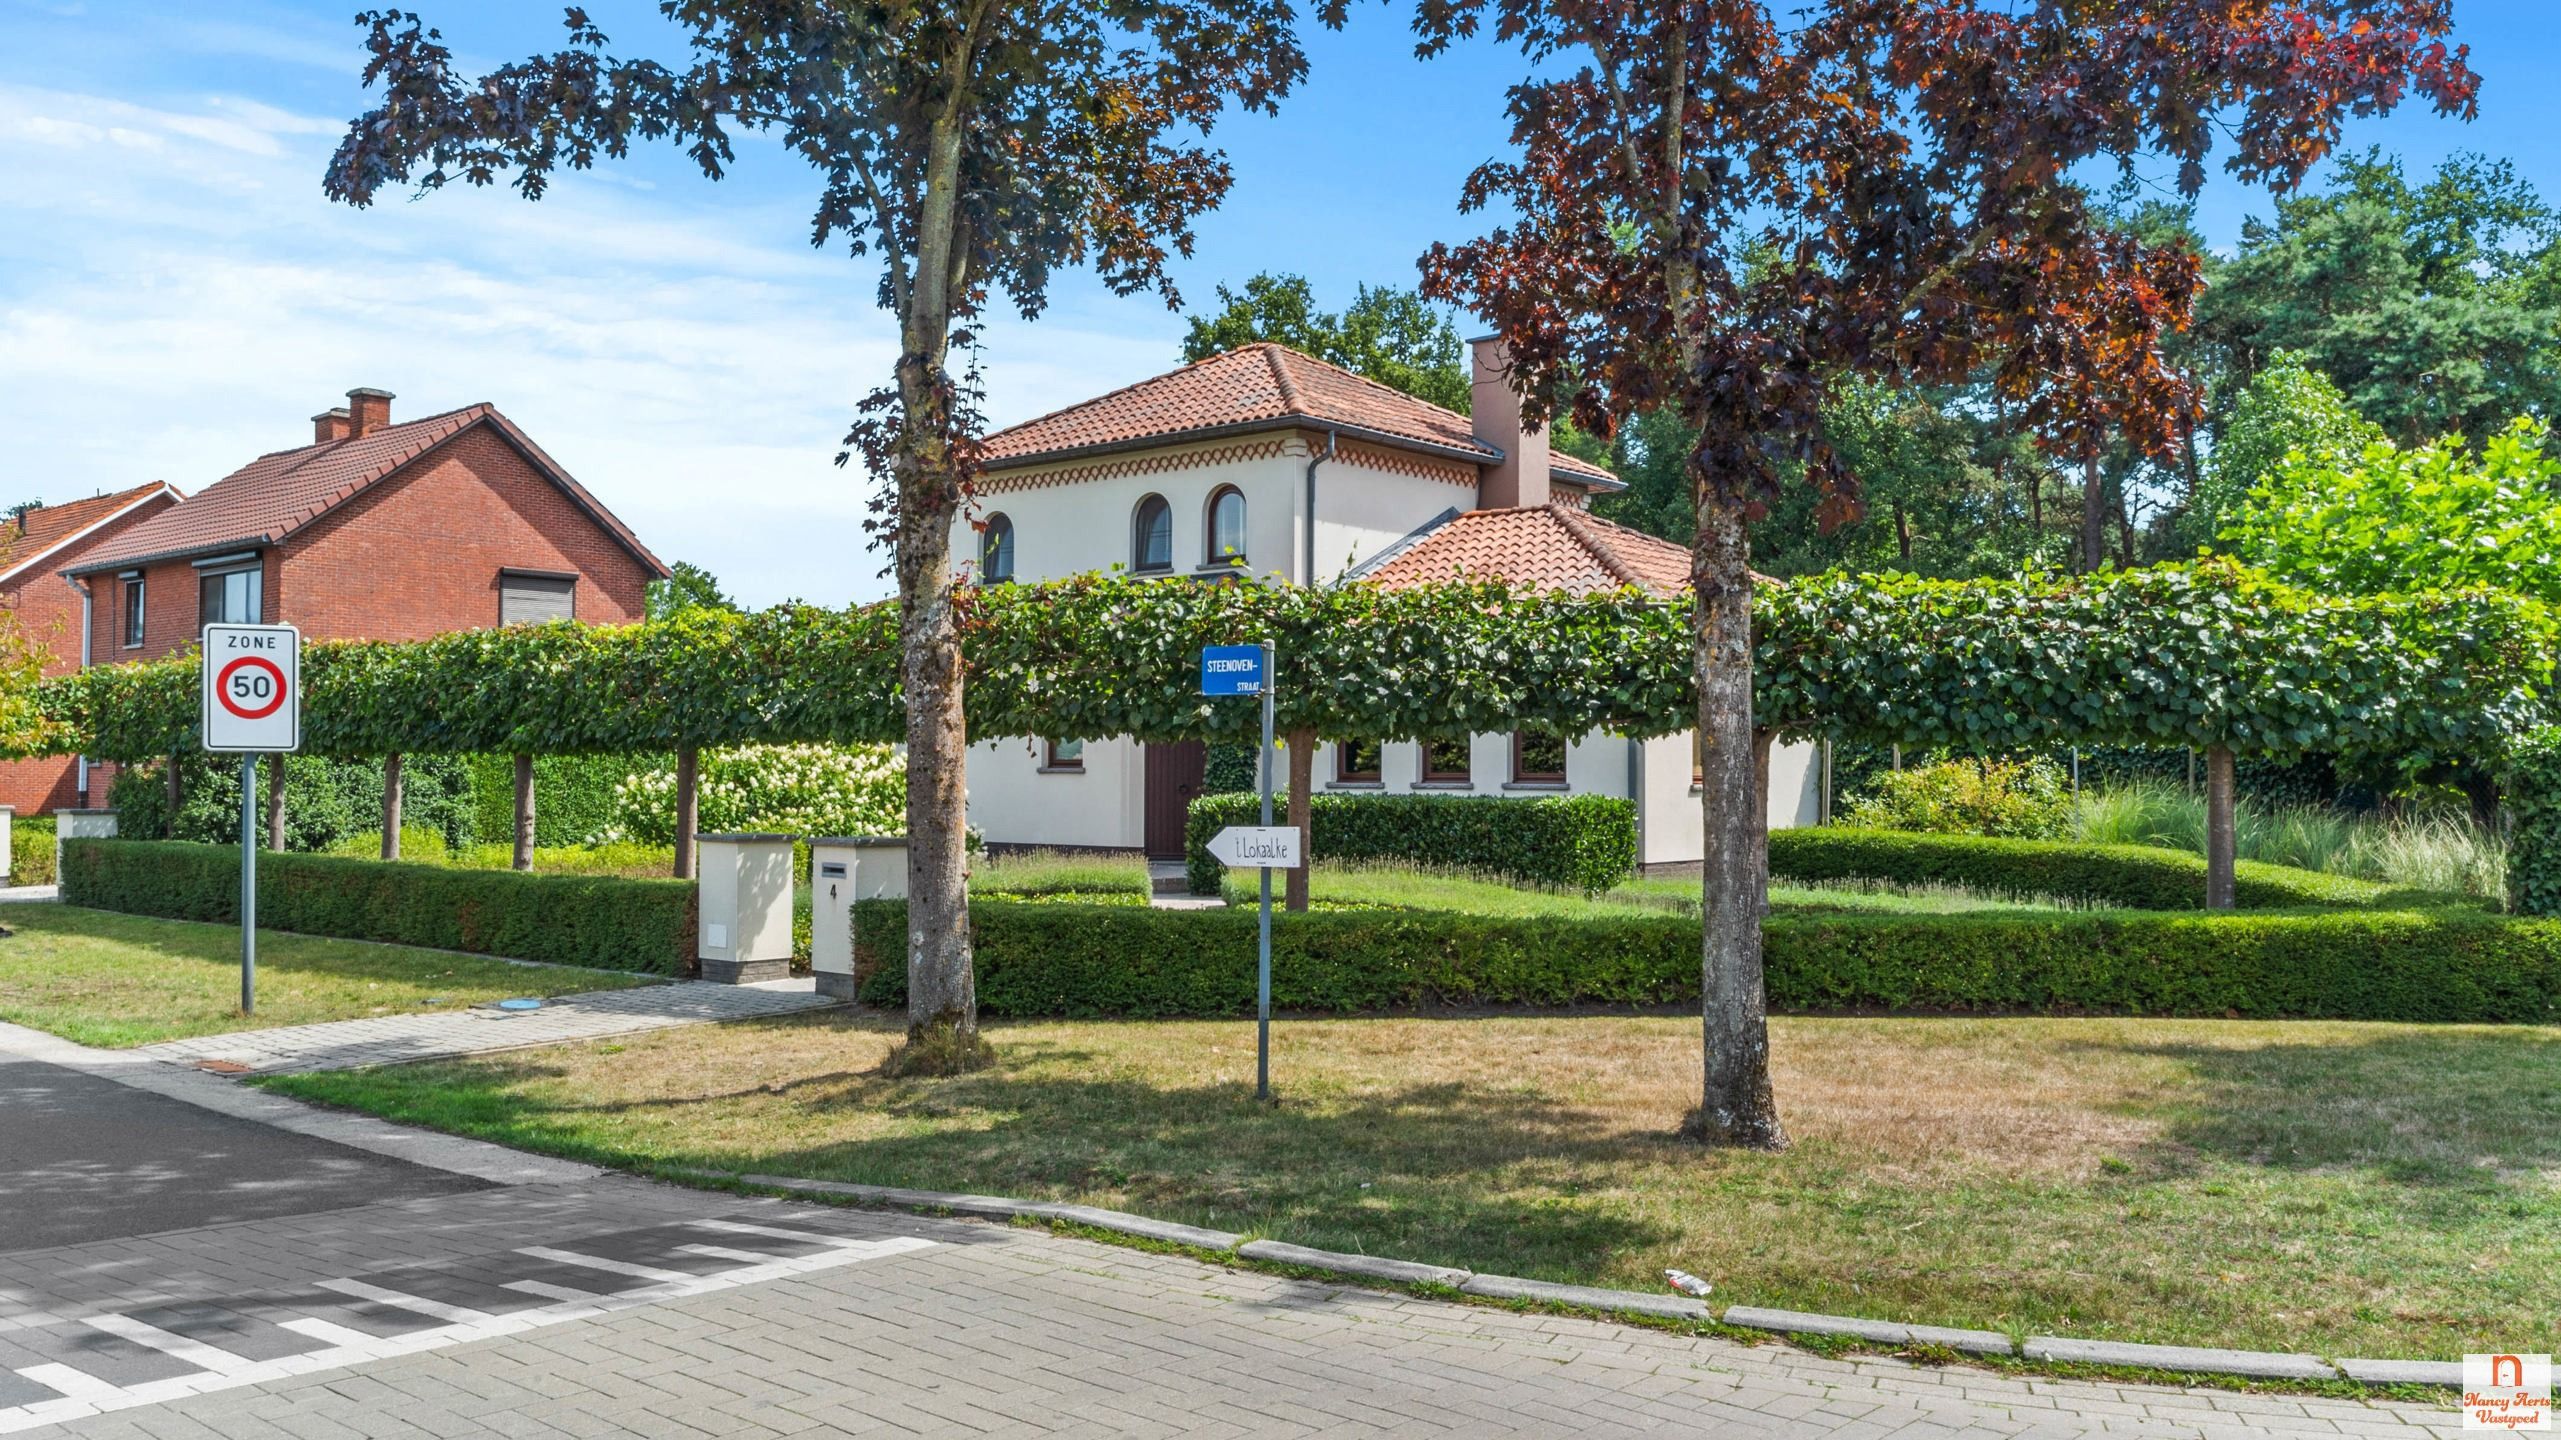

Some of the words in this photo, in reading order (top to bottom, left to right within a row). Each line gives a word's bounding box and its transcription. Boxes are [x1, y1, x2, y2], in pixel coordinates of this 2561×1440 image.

[228, 635, 276, 649] ZONE
[1207, 659, 1258, 672] STEENOVEN-
[233, 675, 270, 698] 50
[1236, 681, 1260, 692] STRAAT
[830, 883, 837, 900] 4
